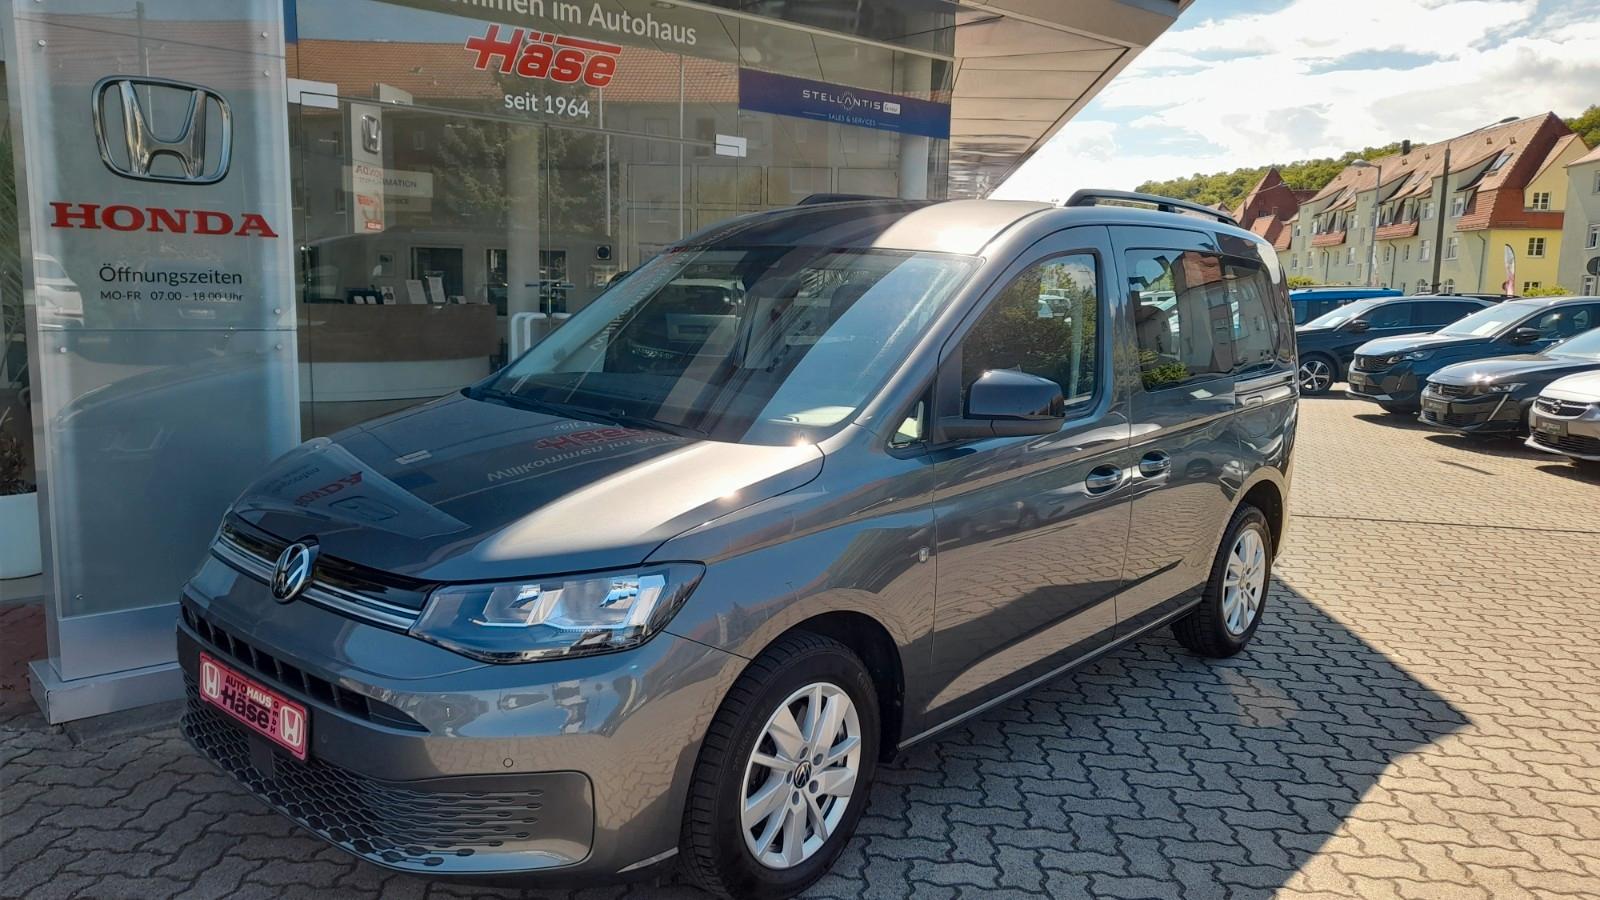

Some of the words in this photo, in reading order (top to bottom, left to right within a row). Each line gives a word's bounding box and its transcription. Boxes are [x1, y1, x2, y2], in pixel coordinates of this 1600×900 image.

[553, 0, 582, 25] im
[587, 3, 697, 46] Autohaus
[464, 22, 624, 88] Häse
[504, 92, 538, 112] seit
[544, 95, 591, 119] 1964
[802, 89, 881, 110] STELLANTIS
[49, 202, 279, 238] HONDA
[99, 263, 243, 287] Öffnungszeiten
[100, 290, 142, 301] MO-FR
[150, 291, 182, 301] 07.00
[220, 683, 272, 730] Häse
[225, 675, 273, 709] AUTOHAUS
